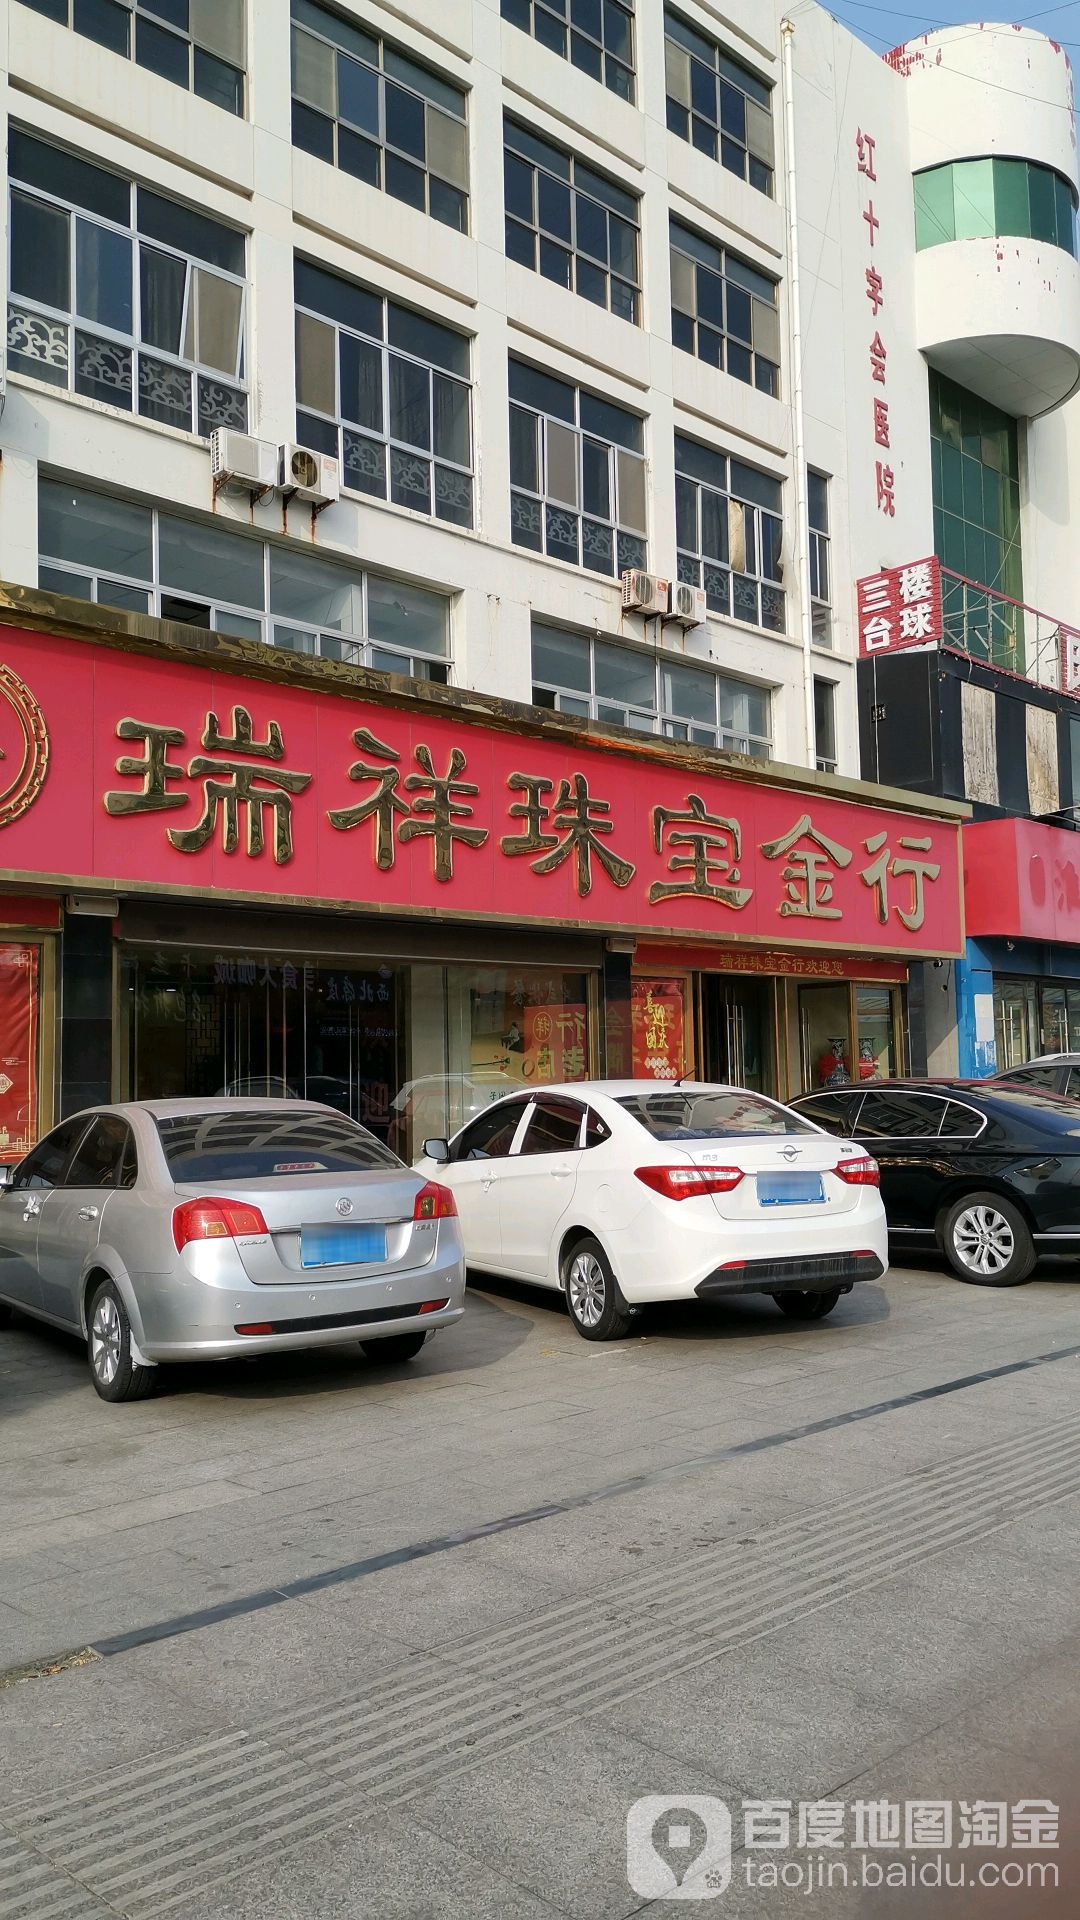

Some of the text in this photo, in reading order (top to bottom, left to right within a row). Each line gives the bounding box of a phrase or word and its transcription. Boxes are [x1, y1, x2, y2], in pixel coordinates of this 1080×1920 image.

[856, 125, 896, 519] 红十字会医院
[862, 563, 934, 614] 三楼
[862, 603, 935, 652] 台球
[103, 705, 941, 932] 瑞祥珠宝金行
[720, 953, 844, 976] 瑞祥珠宝金行欢迎您
